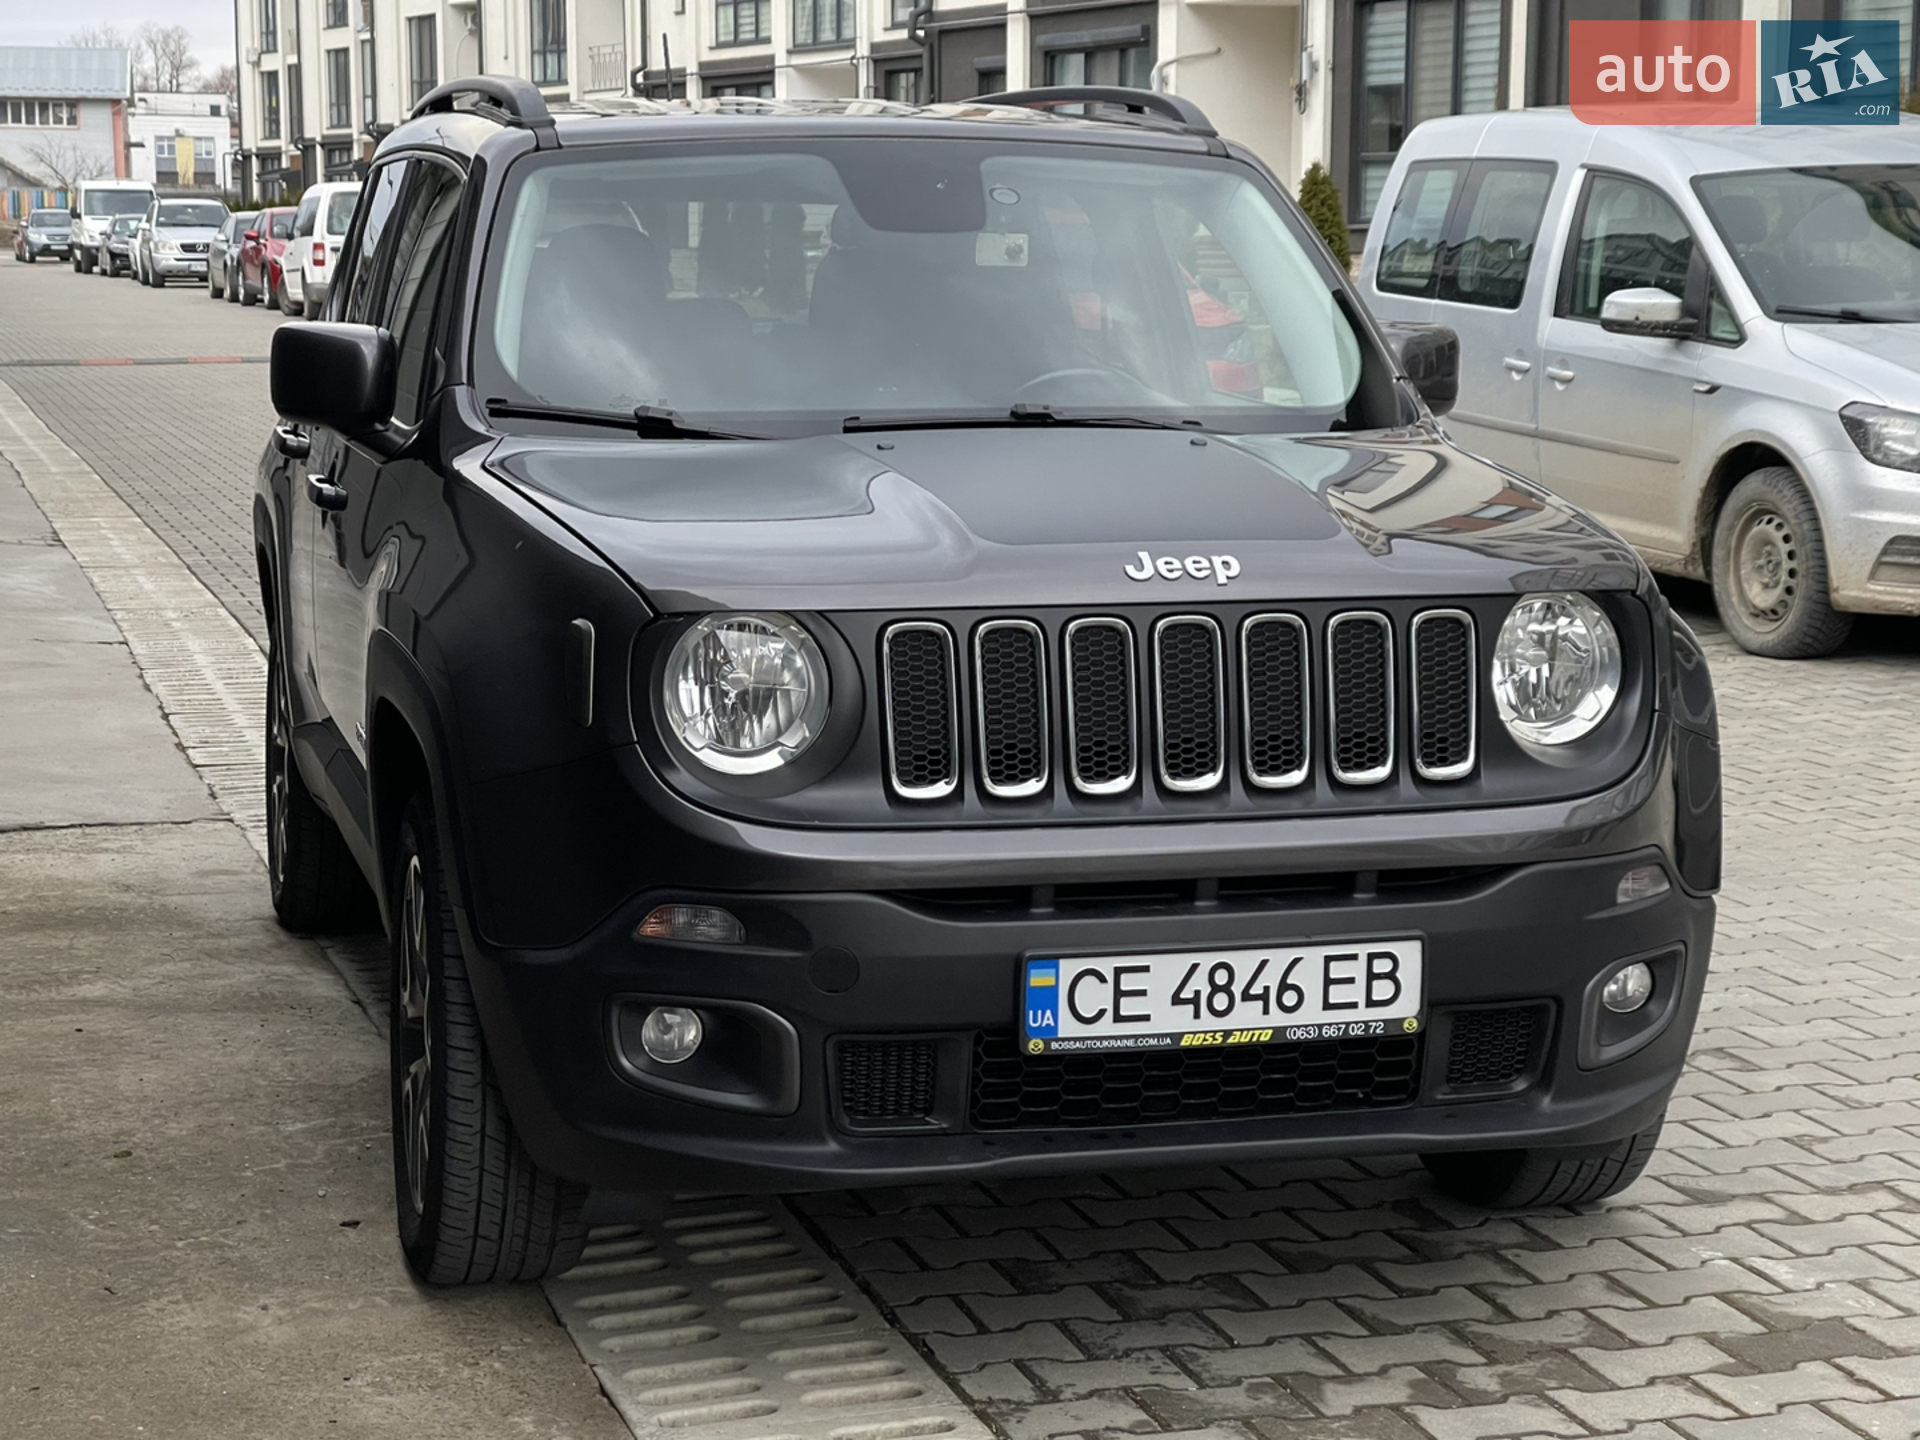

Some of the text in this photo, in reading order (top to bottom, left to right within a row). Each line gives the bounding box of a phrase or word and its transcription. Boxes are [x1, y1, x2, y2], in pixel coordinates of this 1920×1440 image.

[1123, 551, 1241, 586] Jeep
[1067, 950, 1402, 1025] CE 4846 EB
[1028, 1008, 1055, 1028] UA
[1180, 1029, 1274, 1046] BOSS AUTO
[1286, 1021, 1385, 1040] (063) 667 02 72
[1050, 1037, 1172, 1050] BOSSAUTOUKRAINE.COM.UA
